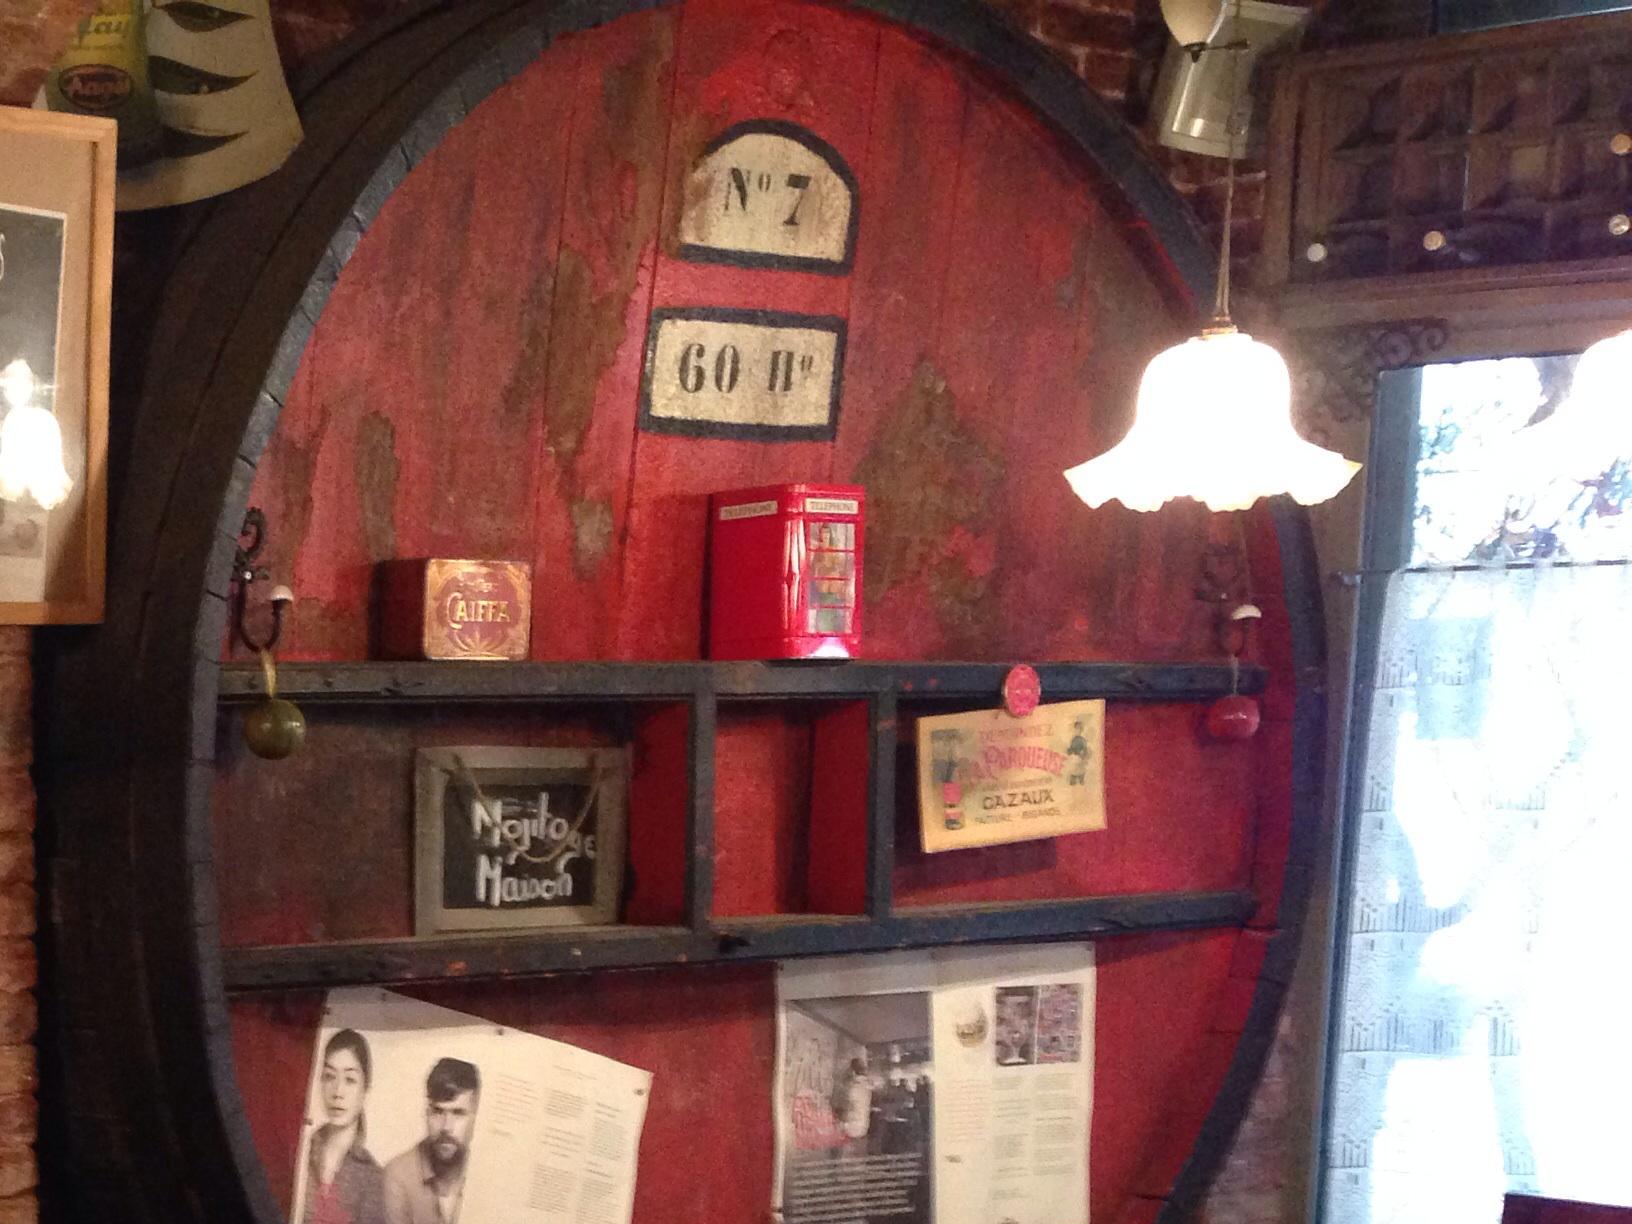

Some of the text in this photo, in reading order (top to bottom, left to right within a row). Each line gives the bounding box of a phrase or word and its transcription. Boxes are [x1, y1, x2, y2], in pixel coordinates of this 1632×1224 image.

[782, 172, 813, 227] 7
[678, 342, 741, 394] 60
[982, 788, 1054, 810] CAZAUX
[471, 791, 569, 865] Mojito
[475, 854, 574, 908] Maison
